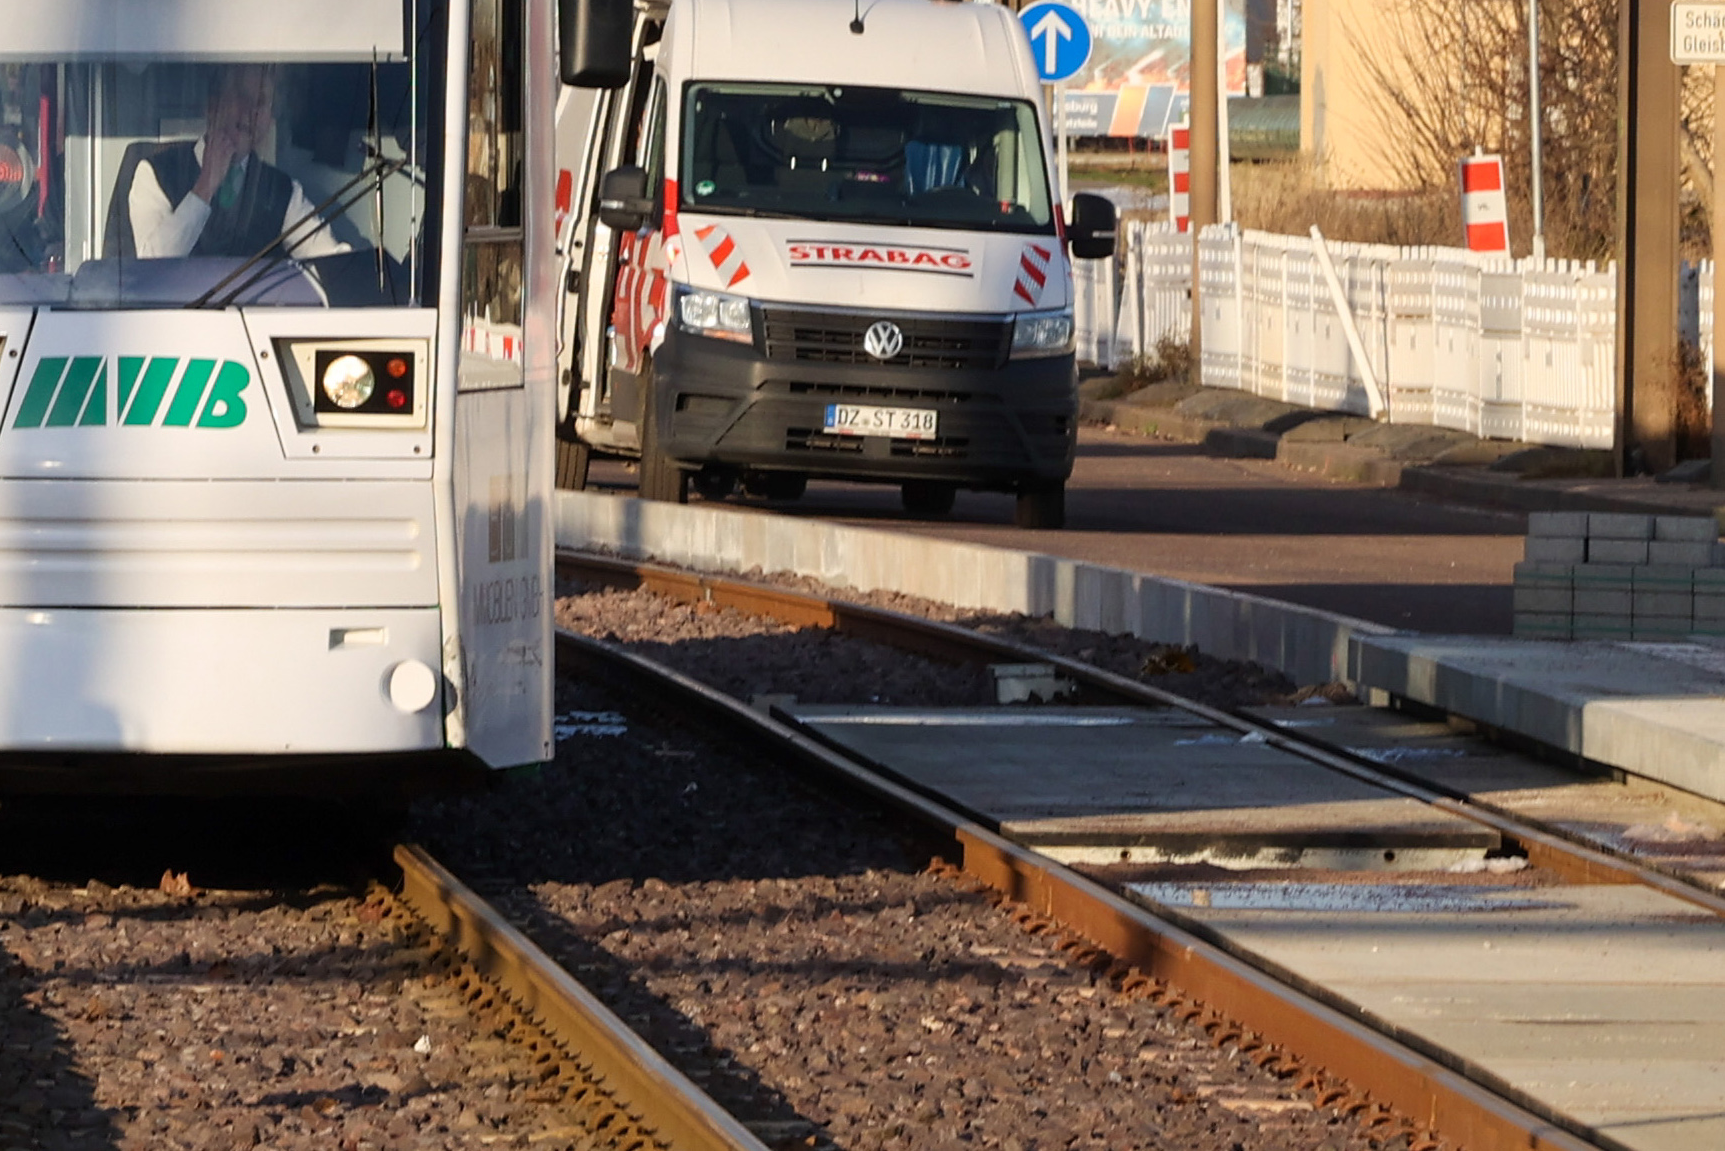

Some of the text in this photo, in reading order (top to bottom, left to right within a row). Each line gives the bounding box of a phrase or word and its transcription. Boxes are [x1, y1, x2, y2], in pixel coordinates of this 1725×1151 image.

[788, 245, 972, 270] STRABAG
[837, 408, 934, 431] DZ ST 318
